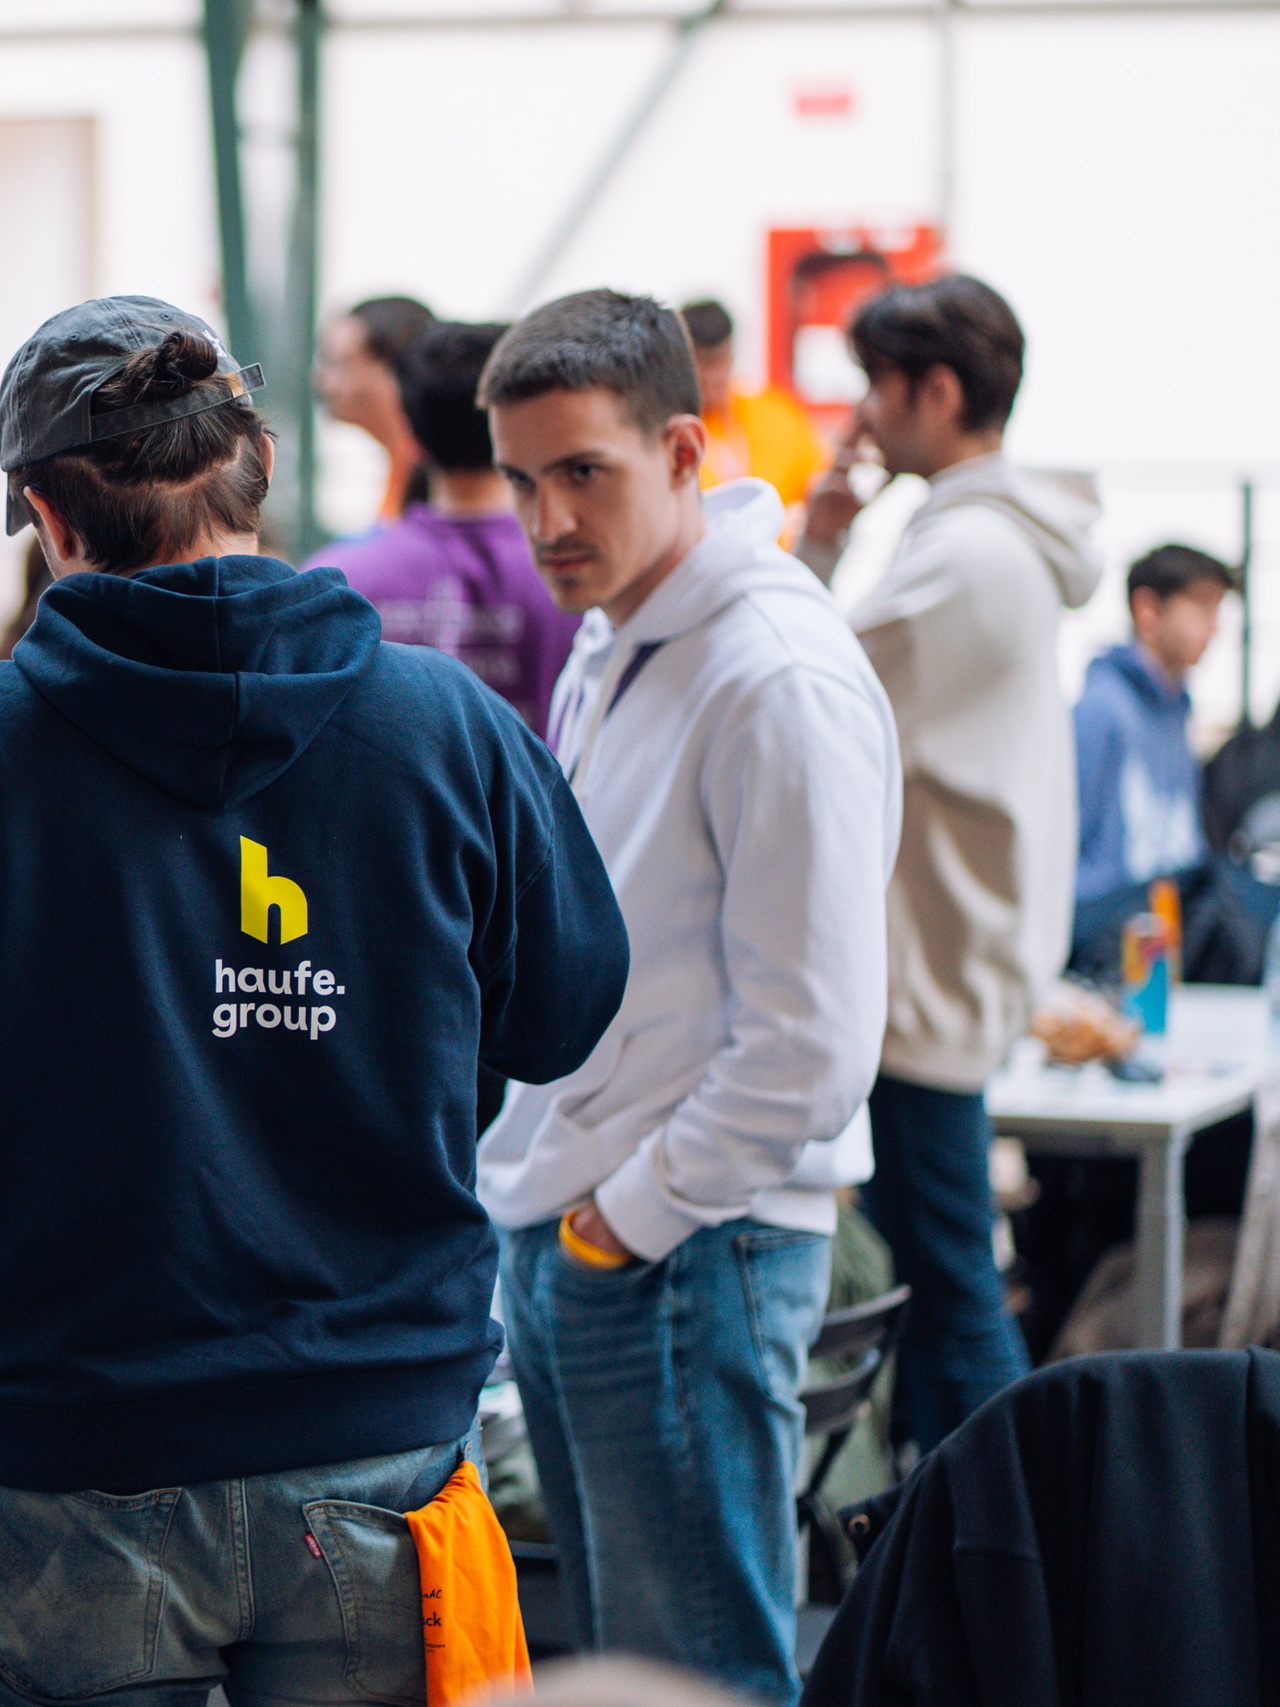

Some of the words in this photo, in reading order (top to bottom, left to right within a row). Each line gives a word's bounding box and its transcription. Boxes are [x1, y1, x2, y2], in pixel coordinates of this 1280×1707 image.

[239, 835, 309, 945] h
[215, 958, 346, 996] haufe.
[211, 1002, 337, 1041] group
[423, 1611, 442, 1627] ck
